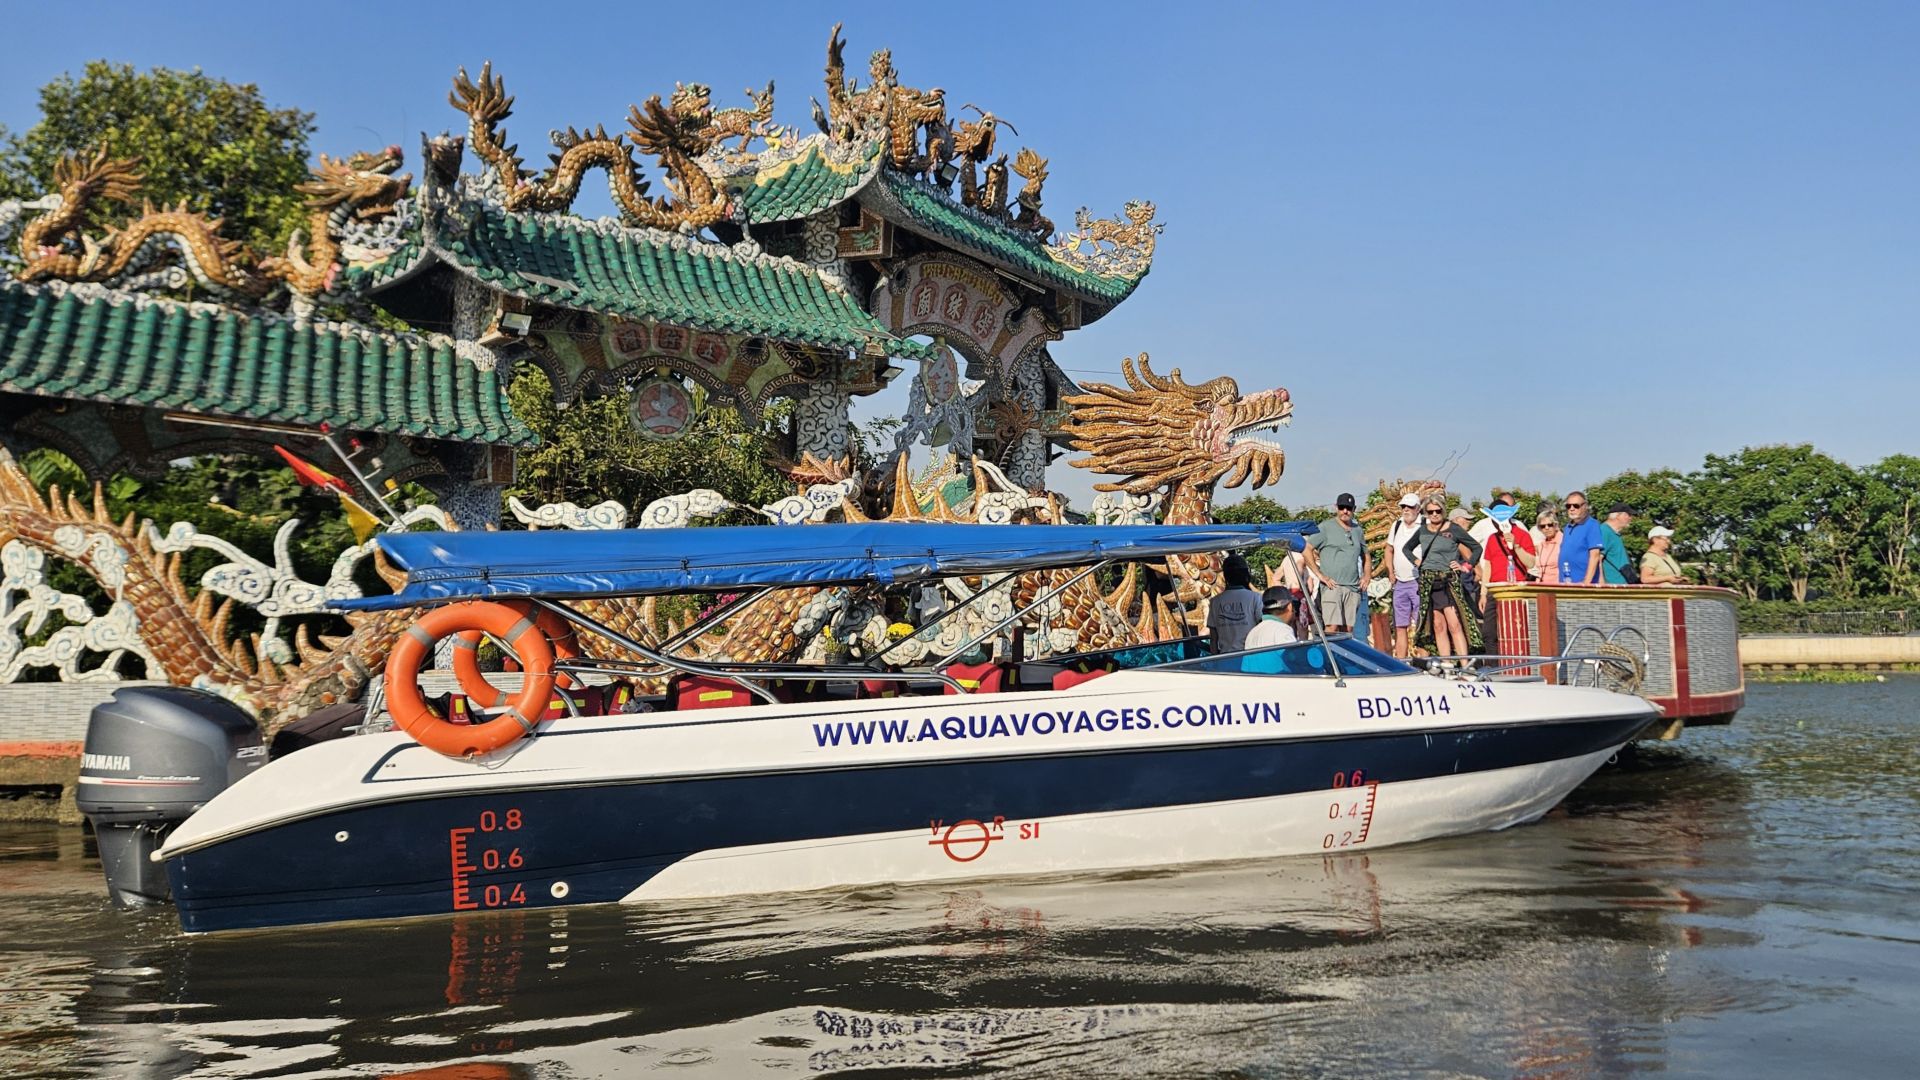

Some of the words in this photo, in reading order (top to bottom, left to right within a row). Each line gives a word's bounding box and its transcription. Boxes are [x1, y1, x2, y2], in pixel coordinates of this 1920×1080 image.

[1357, 695, 1451, 719] BD-0114
[812, 702, 1281, 747] WWW.AQUAVOYAGES.COM.VN
[236, 745, 267, 759] 250
[85, 753, 131, 771] YAMAHA
[480, 809, 522, 832] 0.8
[1329, 803, 1358, 819] 0.4
[930, 819, 943, 835] V
[993, 816, 1005, 832] R
[1019, 822, 1040, 840] SI
[1323, 831, 1352, 849] 0.2
[483, 849, 524, 870] 0.6
[484, 883, 527, 907] 0.4
